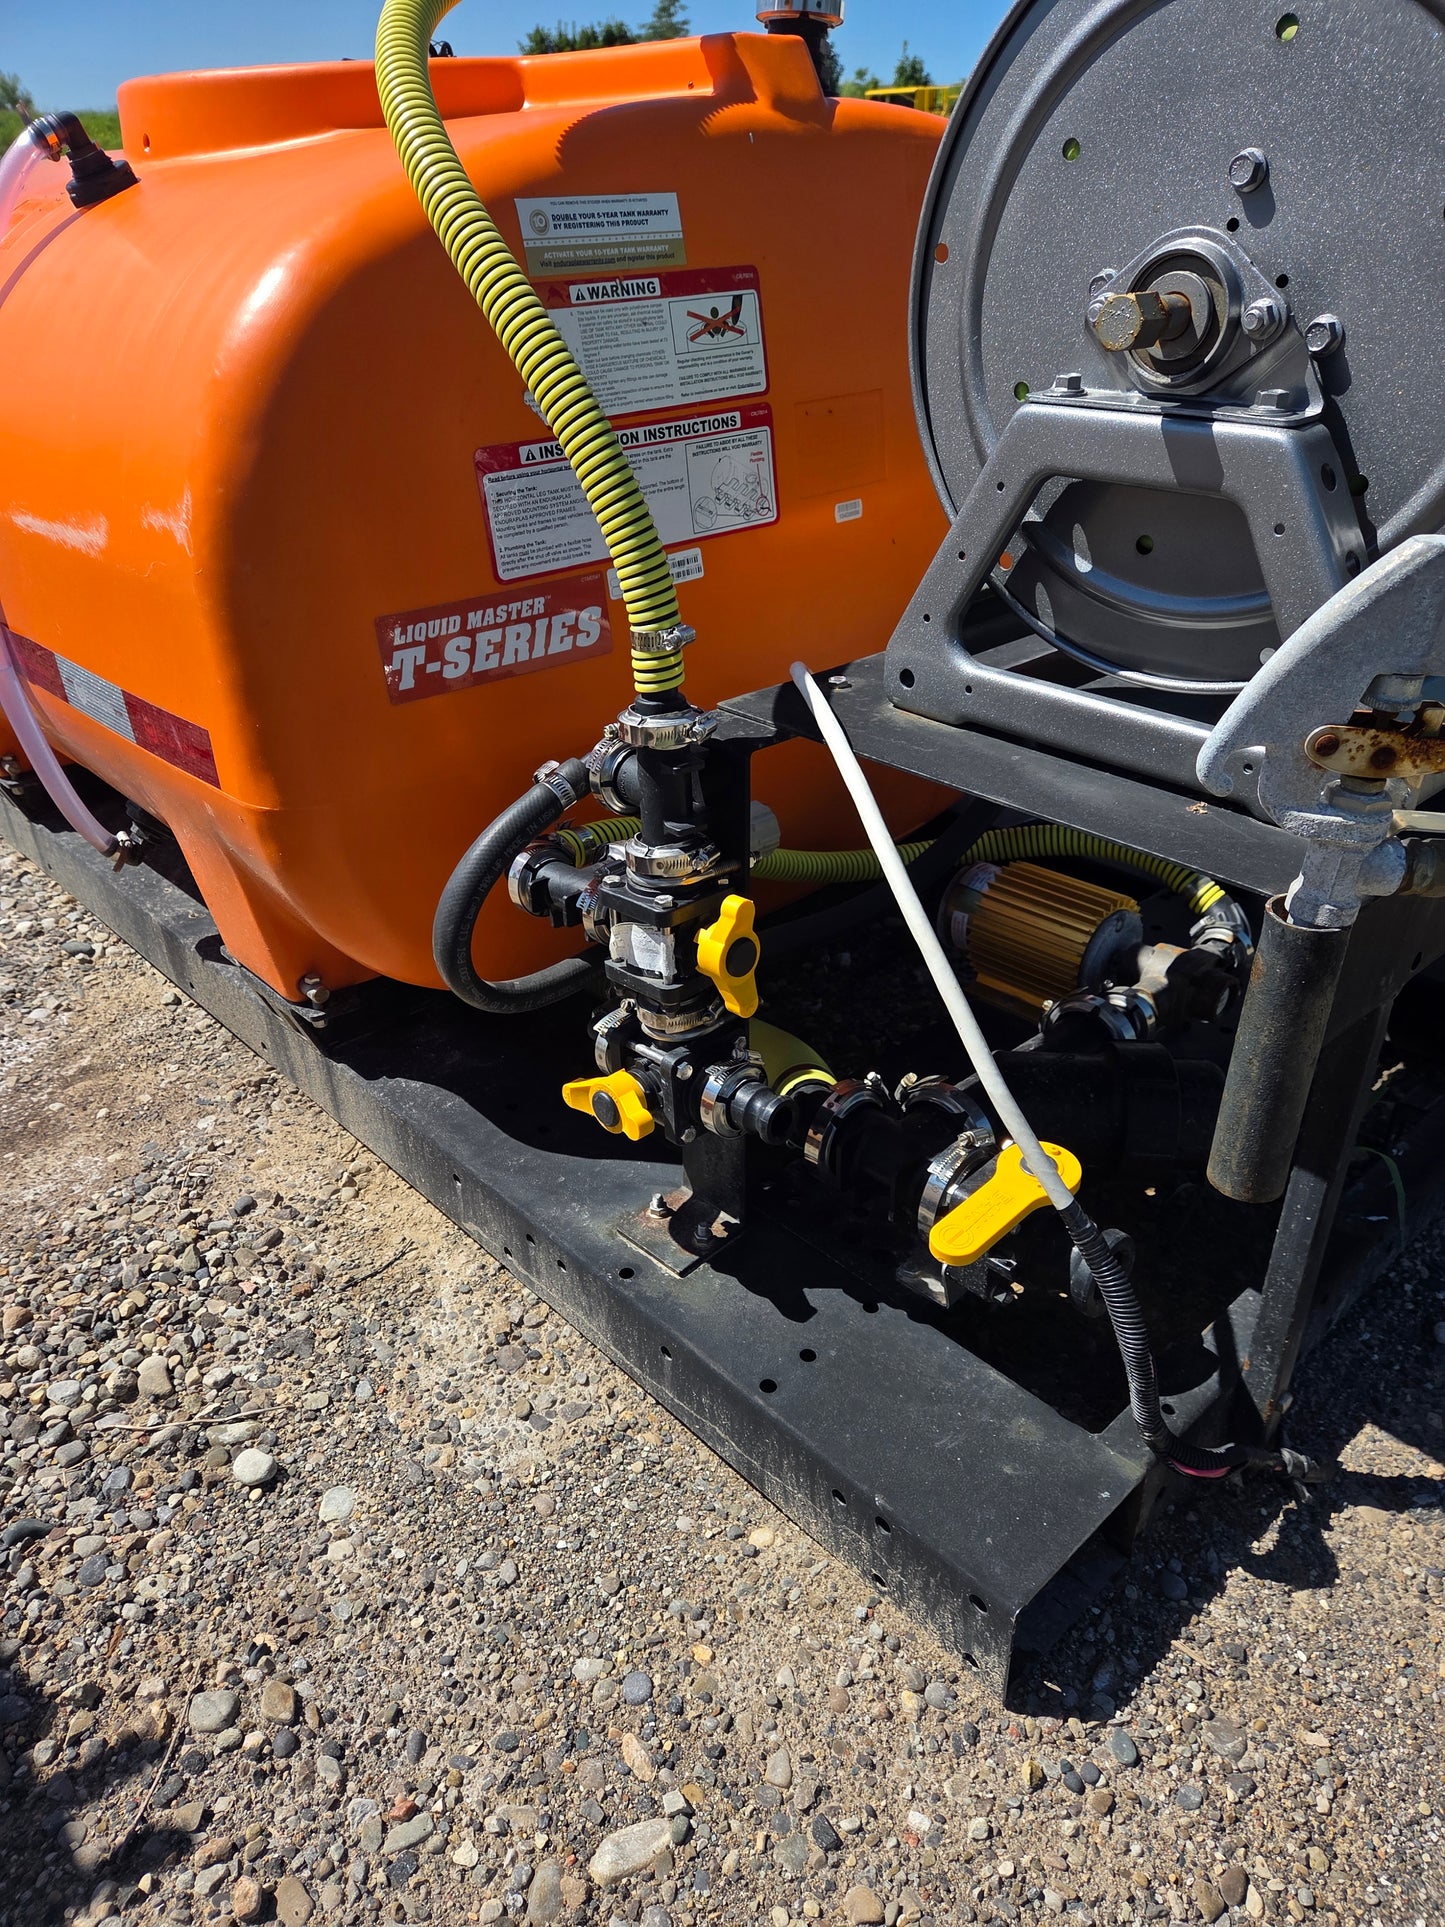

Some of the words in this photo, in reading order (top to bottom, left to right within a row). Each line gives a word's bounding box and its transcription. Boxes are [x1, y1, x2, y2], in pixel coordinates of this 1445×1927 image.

[563, 221, 605, 229] REGISTERING
[543, 251, 574, 260] ACTIVATE
[594, 247, 618, 256] 10-YEAR
[637, 243, 669, 252] WARRANTY
[587, 281, 657, 300] WARNING
[643, 414, 737, 442] INSTRUCTIONS
[539, 494, 571, 503] ENDURAPLAS
[504, 544, 525, 552] Plumbing
[393, 615, 461, 646] LIQUID
[392, 606, 602, 691] T-SERIES
[457, 948, 466, 964] PSI
[504, 837, 521, 857] MADE
[527, 824, 537, 834] IN
